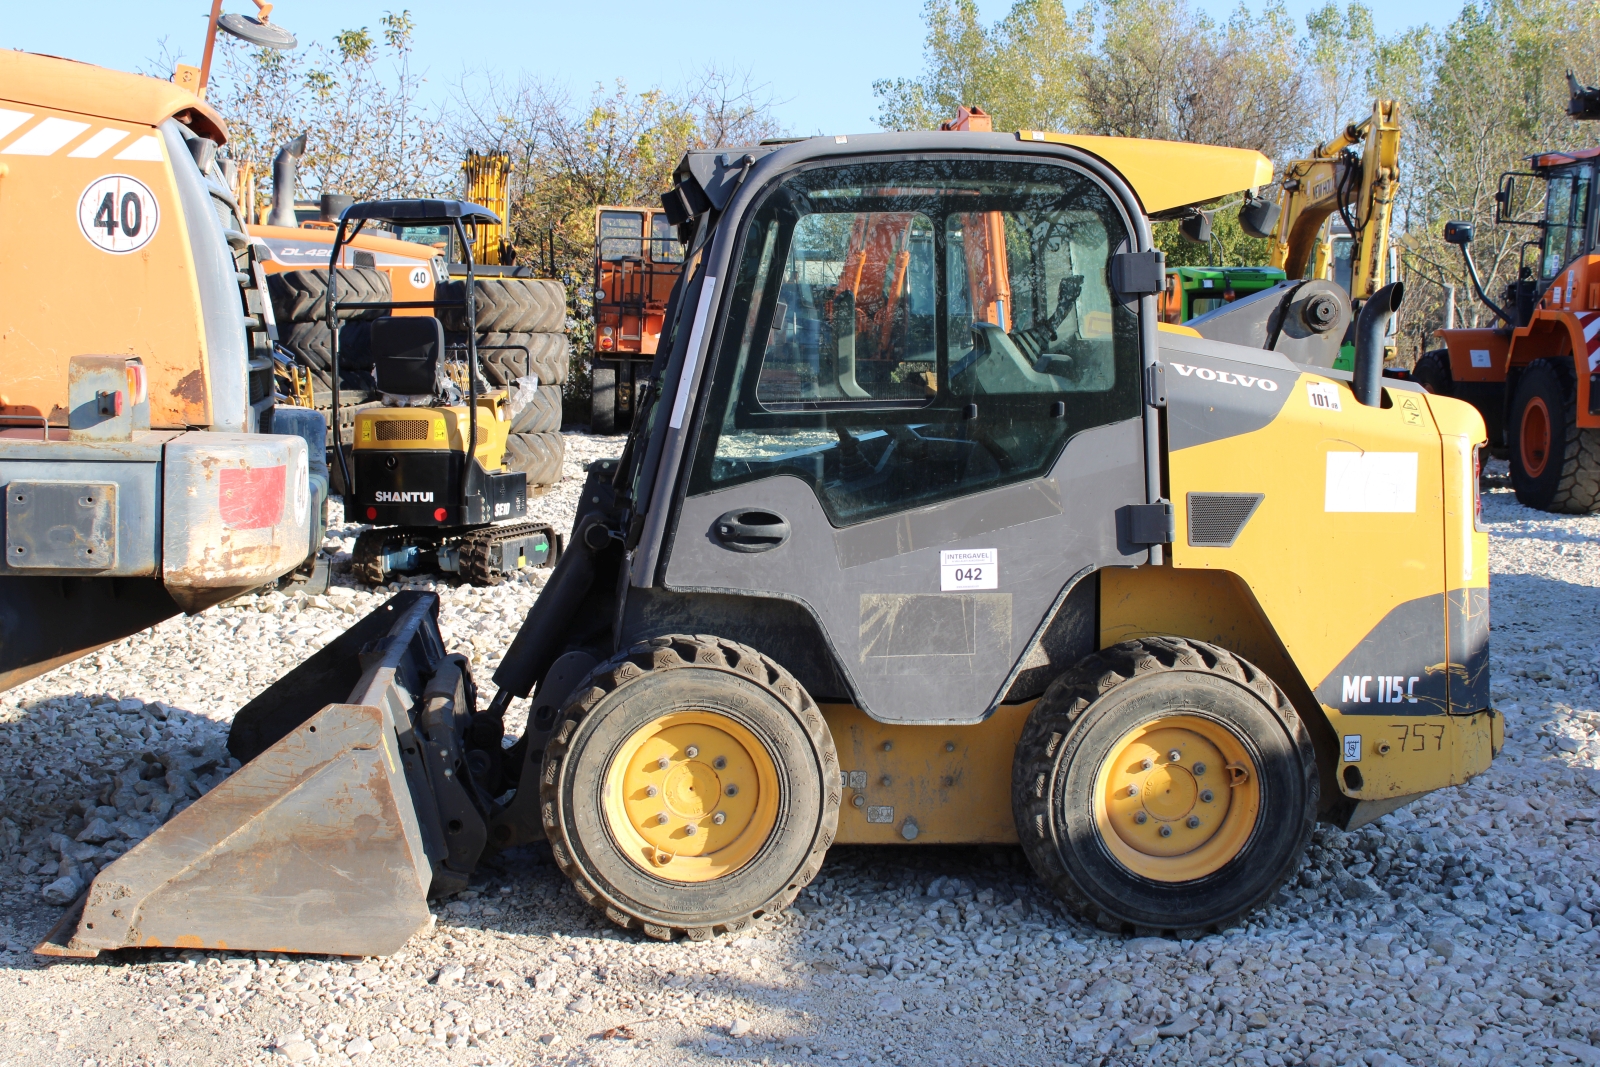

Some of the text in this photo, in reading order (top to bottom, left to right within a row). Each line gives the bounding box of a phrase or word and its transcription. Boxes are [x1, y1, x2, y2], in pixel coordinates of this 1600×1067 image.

[93, 191, 142, 238] 40
[413, 271, 426, 284] 40
[1169, 362, 1279, 392] VOLVO
[1311, 393, 1330, 408] 101
[375, 491, 434, 503] SHANTUI
[947, 552, 989, 560] INTERGAVEL
[955, 567, 982, 581] 042
[1342, 675, 1420, 703] MC 115 C
[1388, 722, 1445, 752] 757
